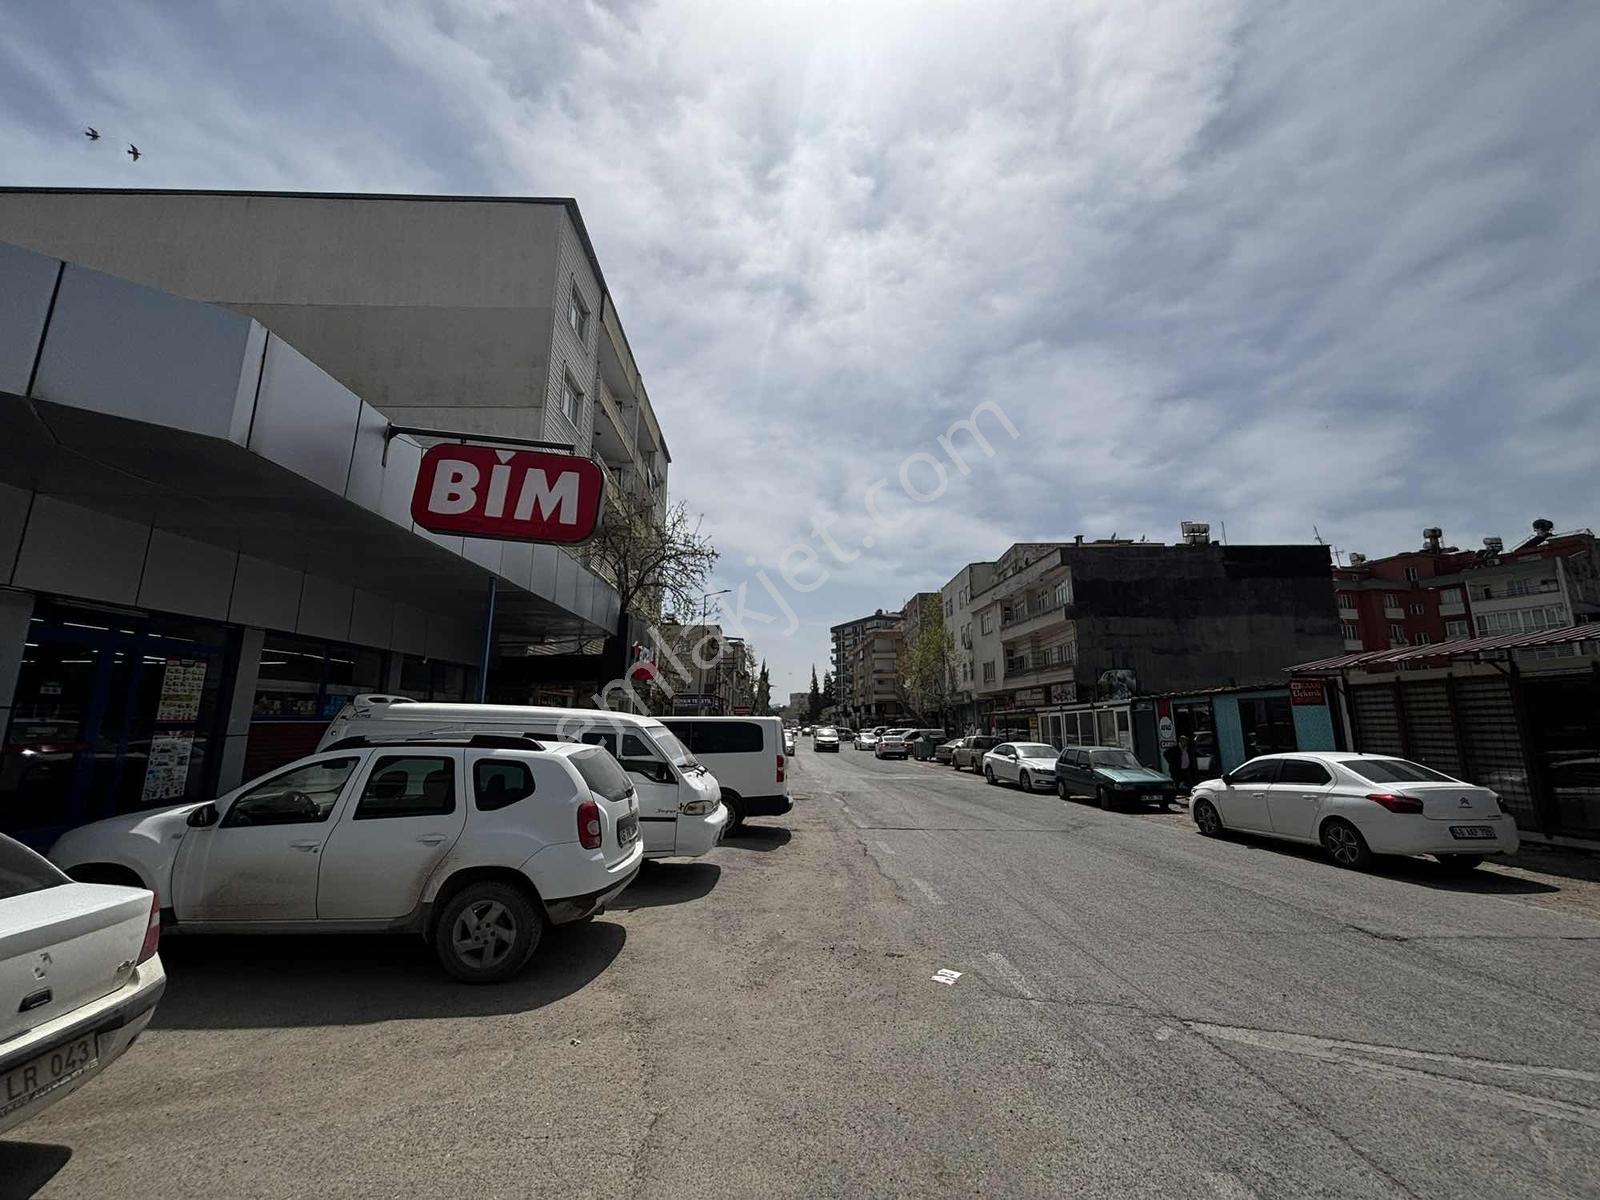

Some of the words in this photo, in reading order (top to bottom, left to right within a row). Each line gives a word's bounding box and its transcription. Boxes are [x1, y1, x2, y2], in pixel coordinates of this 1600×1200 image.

[427, 449, 580, 526] BİM
[7, 1066, 37, 1101] LR
[51, 1040, 89, 1077] 043
